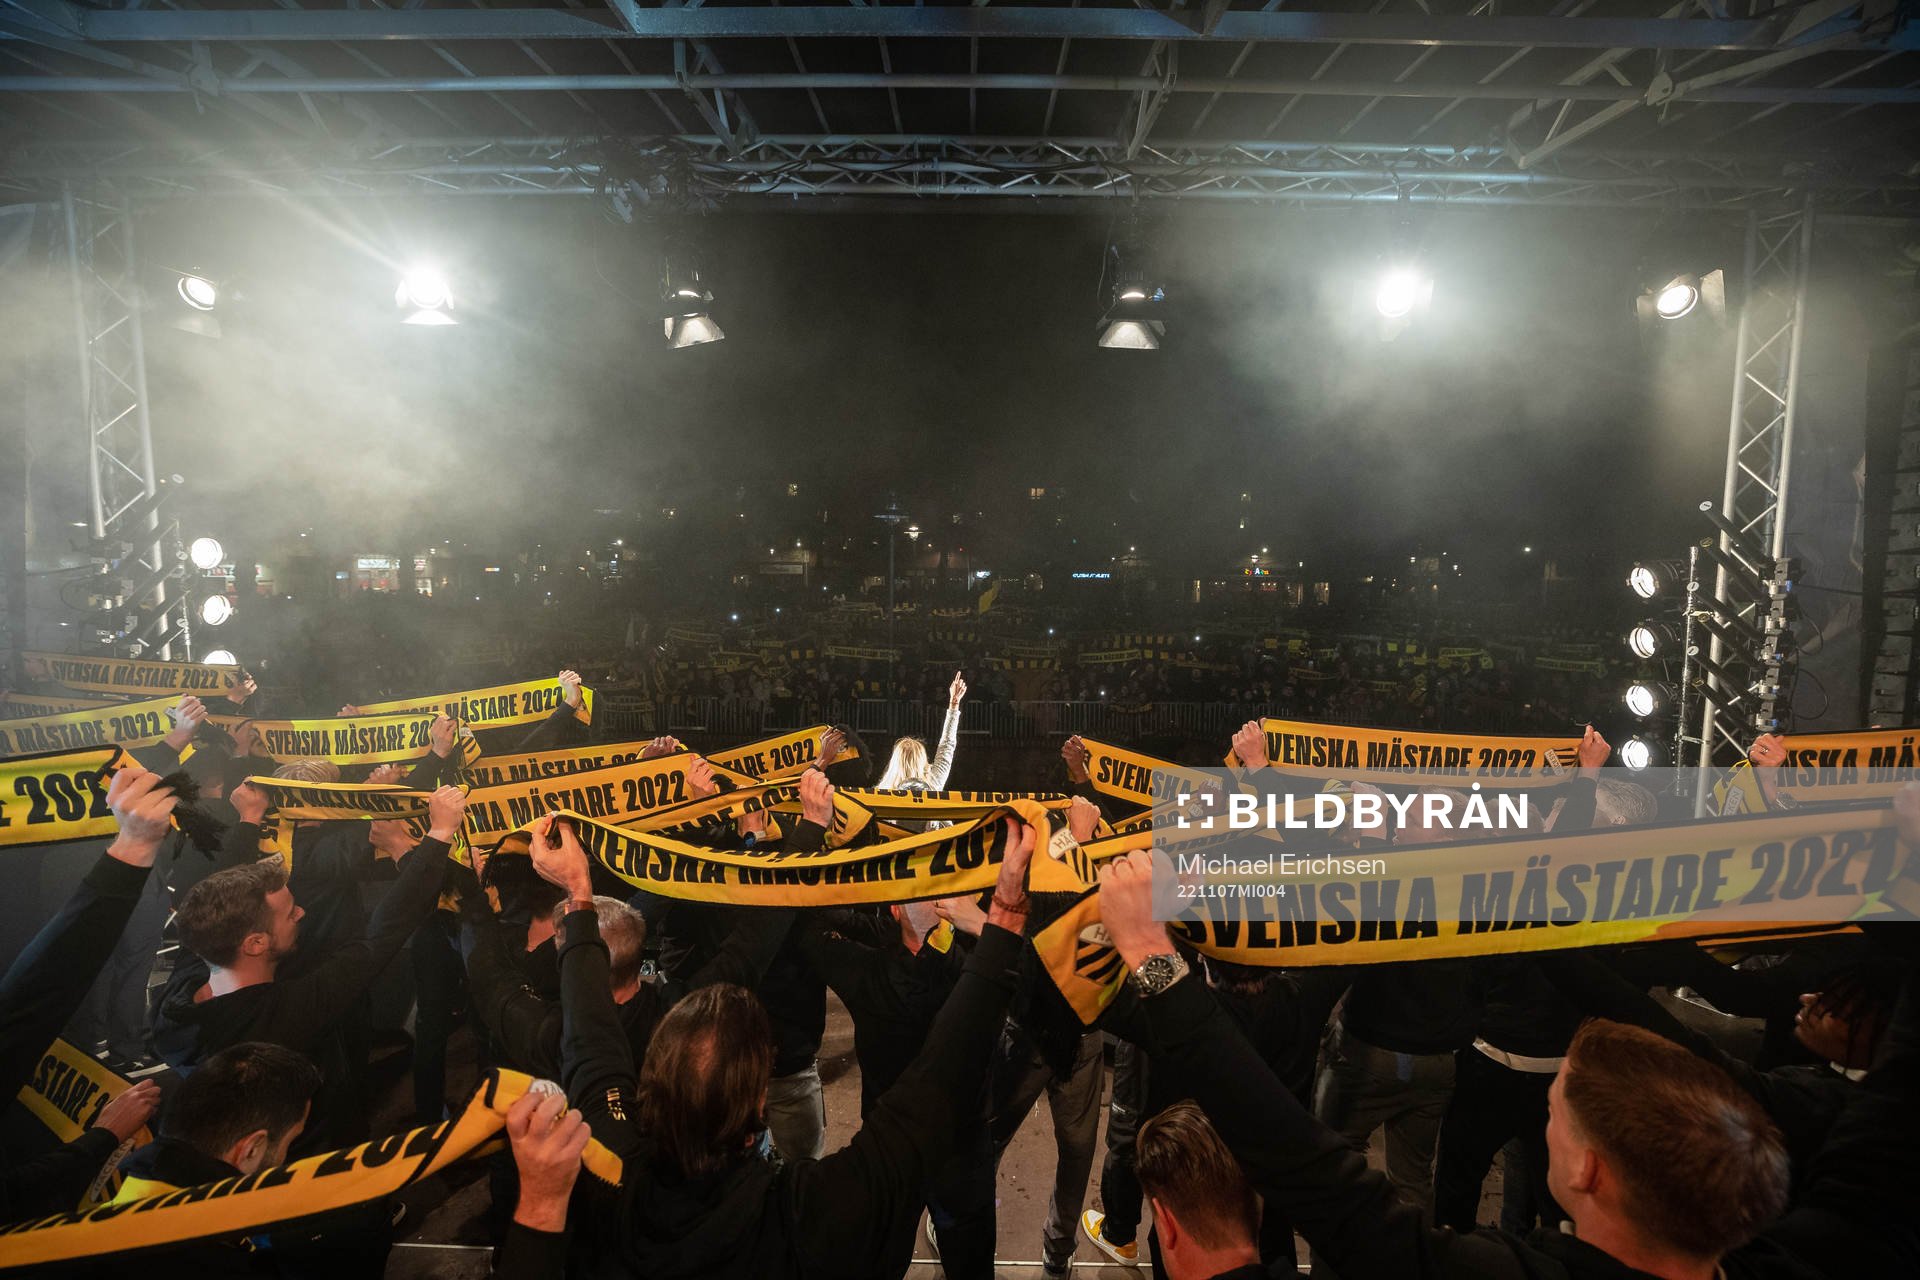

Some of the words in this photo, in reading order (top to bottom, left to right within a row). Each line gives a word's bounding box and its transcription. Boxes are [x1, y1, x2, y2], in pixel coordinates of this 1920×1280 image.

[52, 660, 109, 685] SVENSKA
[113, 663, 179, 688] MÄSTARE
[180, 668, 219, 690] 2022
[522, 686, 563, 715] 2022
[15, 721, 109, 753] MÄSTARE
[110, 711, 165, 743] 2022
[265, 728, 331, 756] SVENSKA
[334, 723, 406, 755] MÄSTARE
[770, 738, 817, 771] 2022
[1266, 731, 1359, 769] VENSKA
[1366, 737, 1474, 777] MÄSTARE
[1476, 747, 1537, 778] 2022
[1776, 747, 1859, 788] NSKA
[13, 767, 113, 825] 202
[622, 770, 688, 813] 2022
[1096, 755, 1192, 801] SVENSKA
[1456, 846, 1736, 935] MÄSTARE
[33, 1054, 100, 1126] STARE
